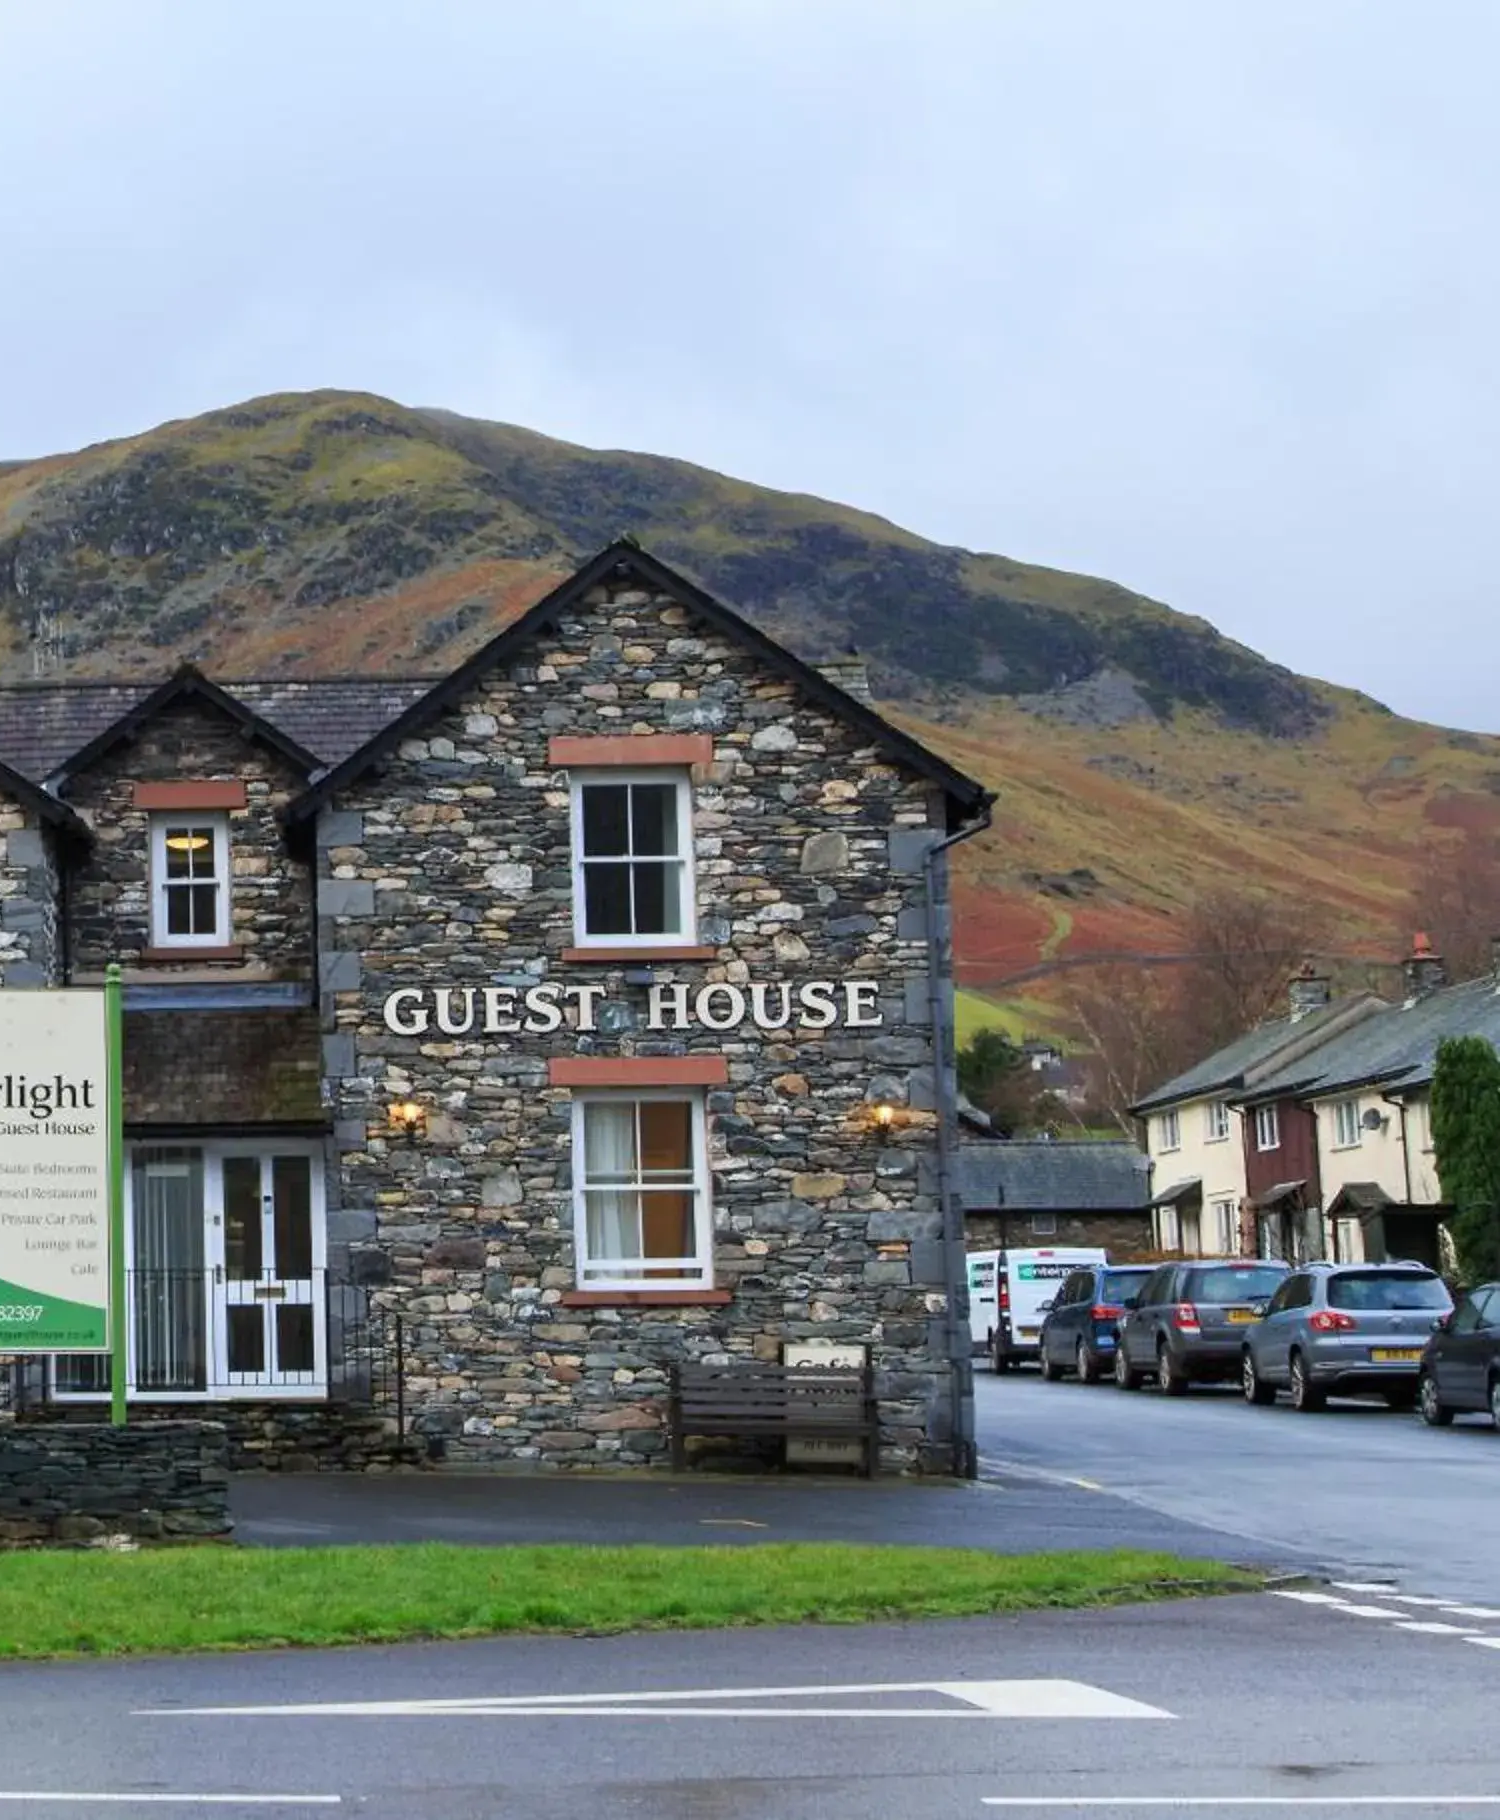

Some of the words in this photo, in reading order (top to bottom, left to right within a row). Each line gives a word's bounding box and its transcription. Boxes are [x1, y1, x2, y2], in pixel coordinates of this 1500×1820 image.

[383, 982, 606, 1035] GUEST
[646, 981, 884, 1030] HOUSE
[45, 1121, 96, 1136] House
[33, 1162, 97, 1175] Bedrooms
[32, 1187, 97, 1200] Restaurant
[69, 1213, 97, 1225] Park
